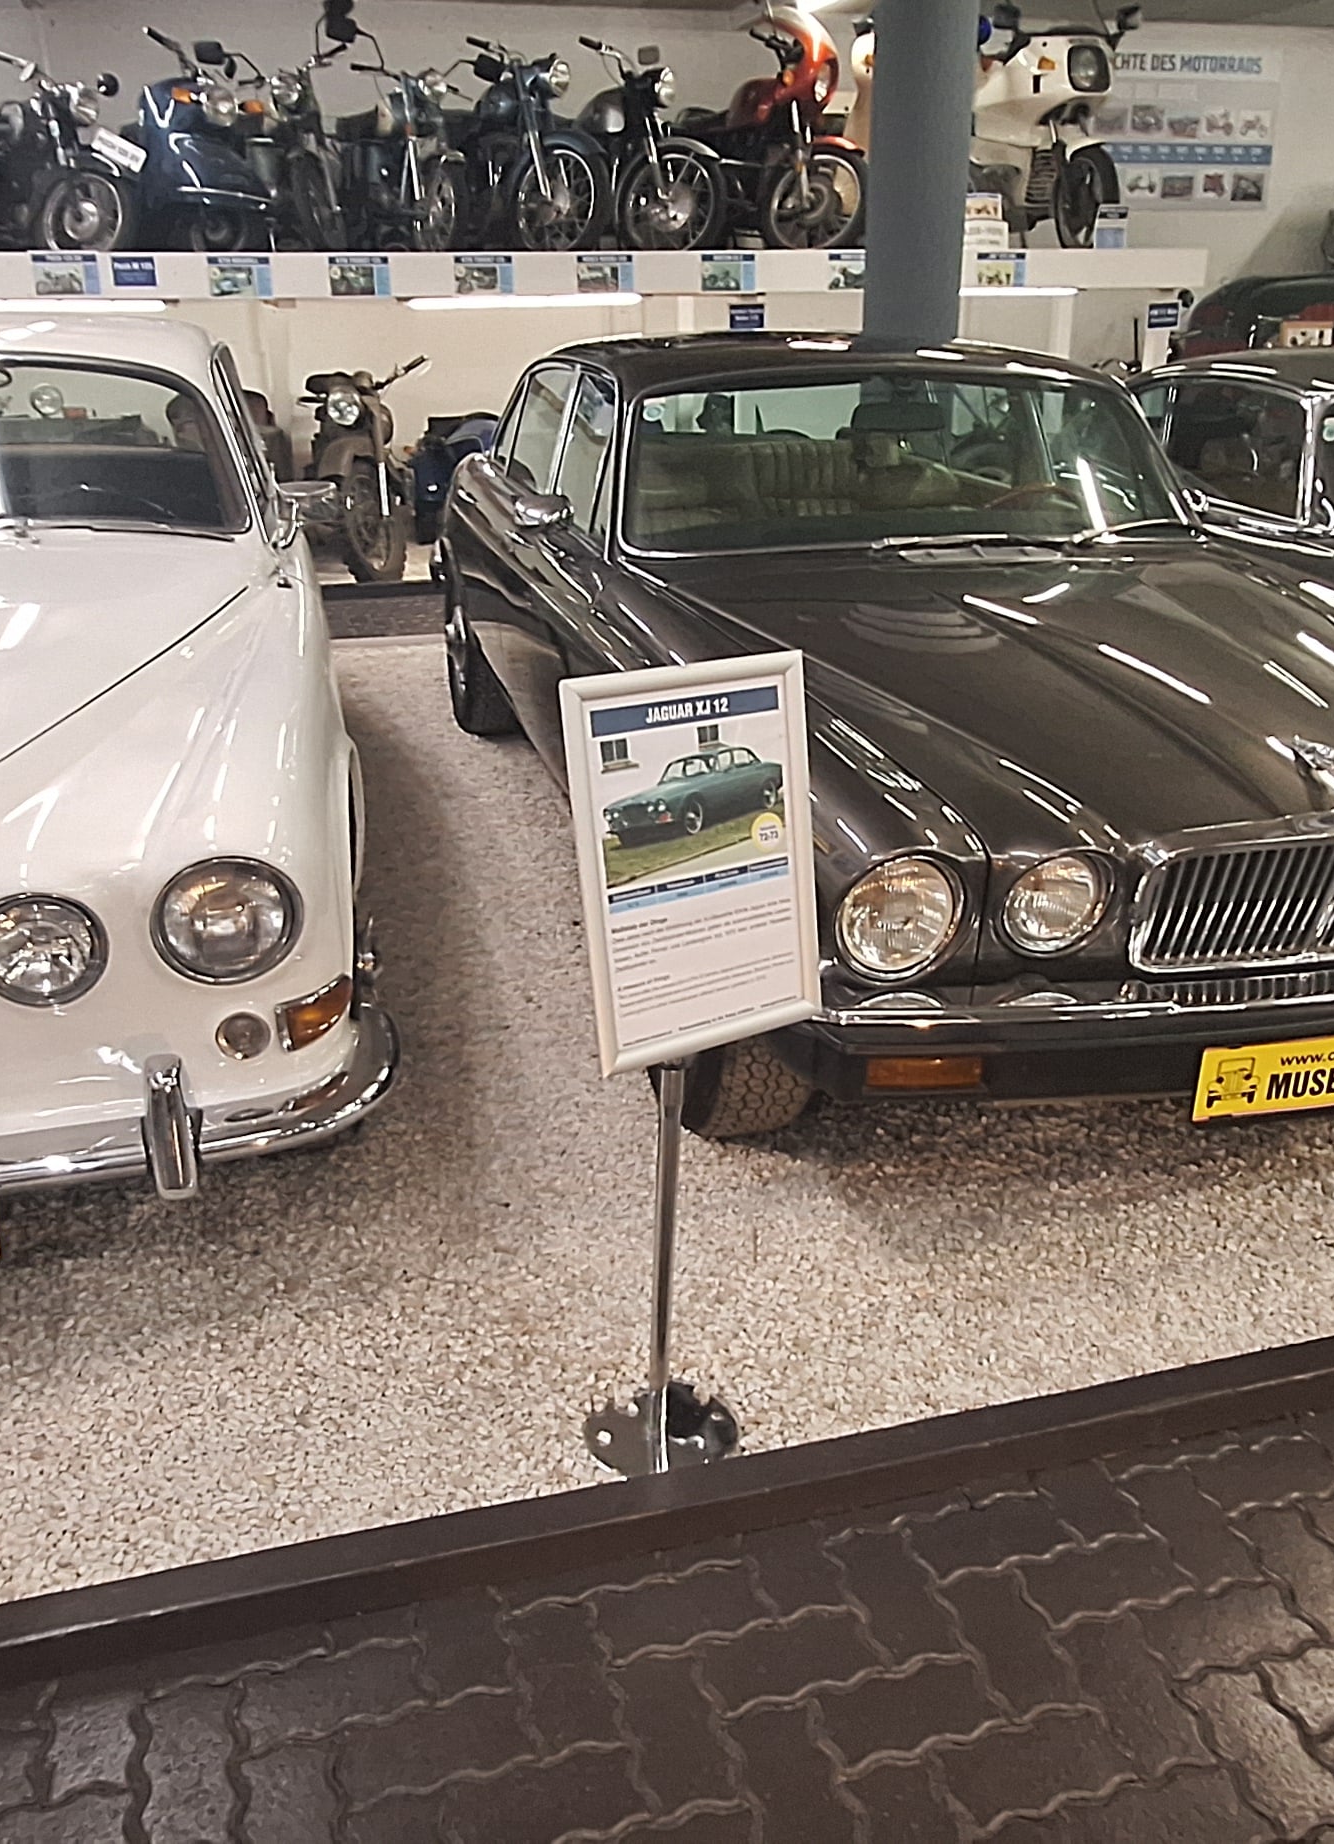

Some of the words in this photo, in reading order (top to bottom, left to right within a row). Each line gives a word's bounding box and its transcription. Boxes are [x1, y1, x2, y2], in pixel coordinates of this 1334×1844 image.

[1151, 54, 1176, 72] DES
[646, 702, 693, 723] JAGUAR
[696, 699, 711, 715] XJ
[714, 697, 729, 713] 12
